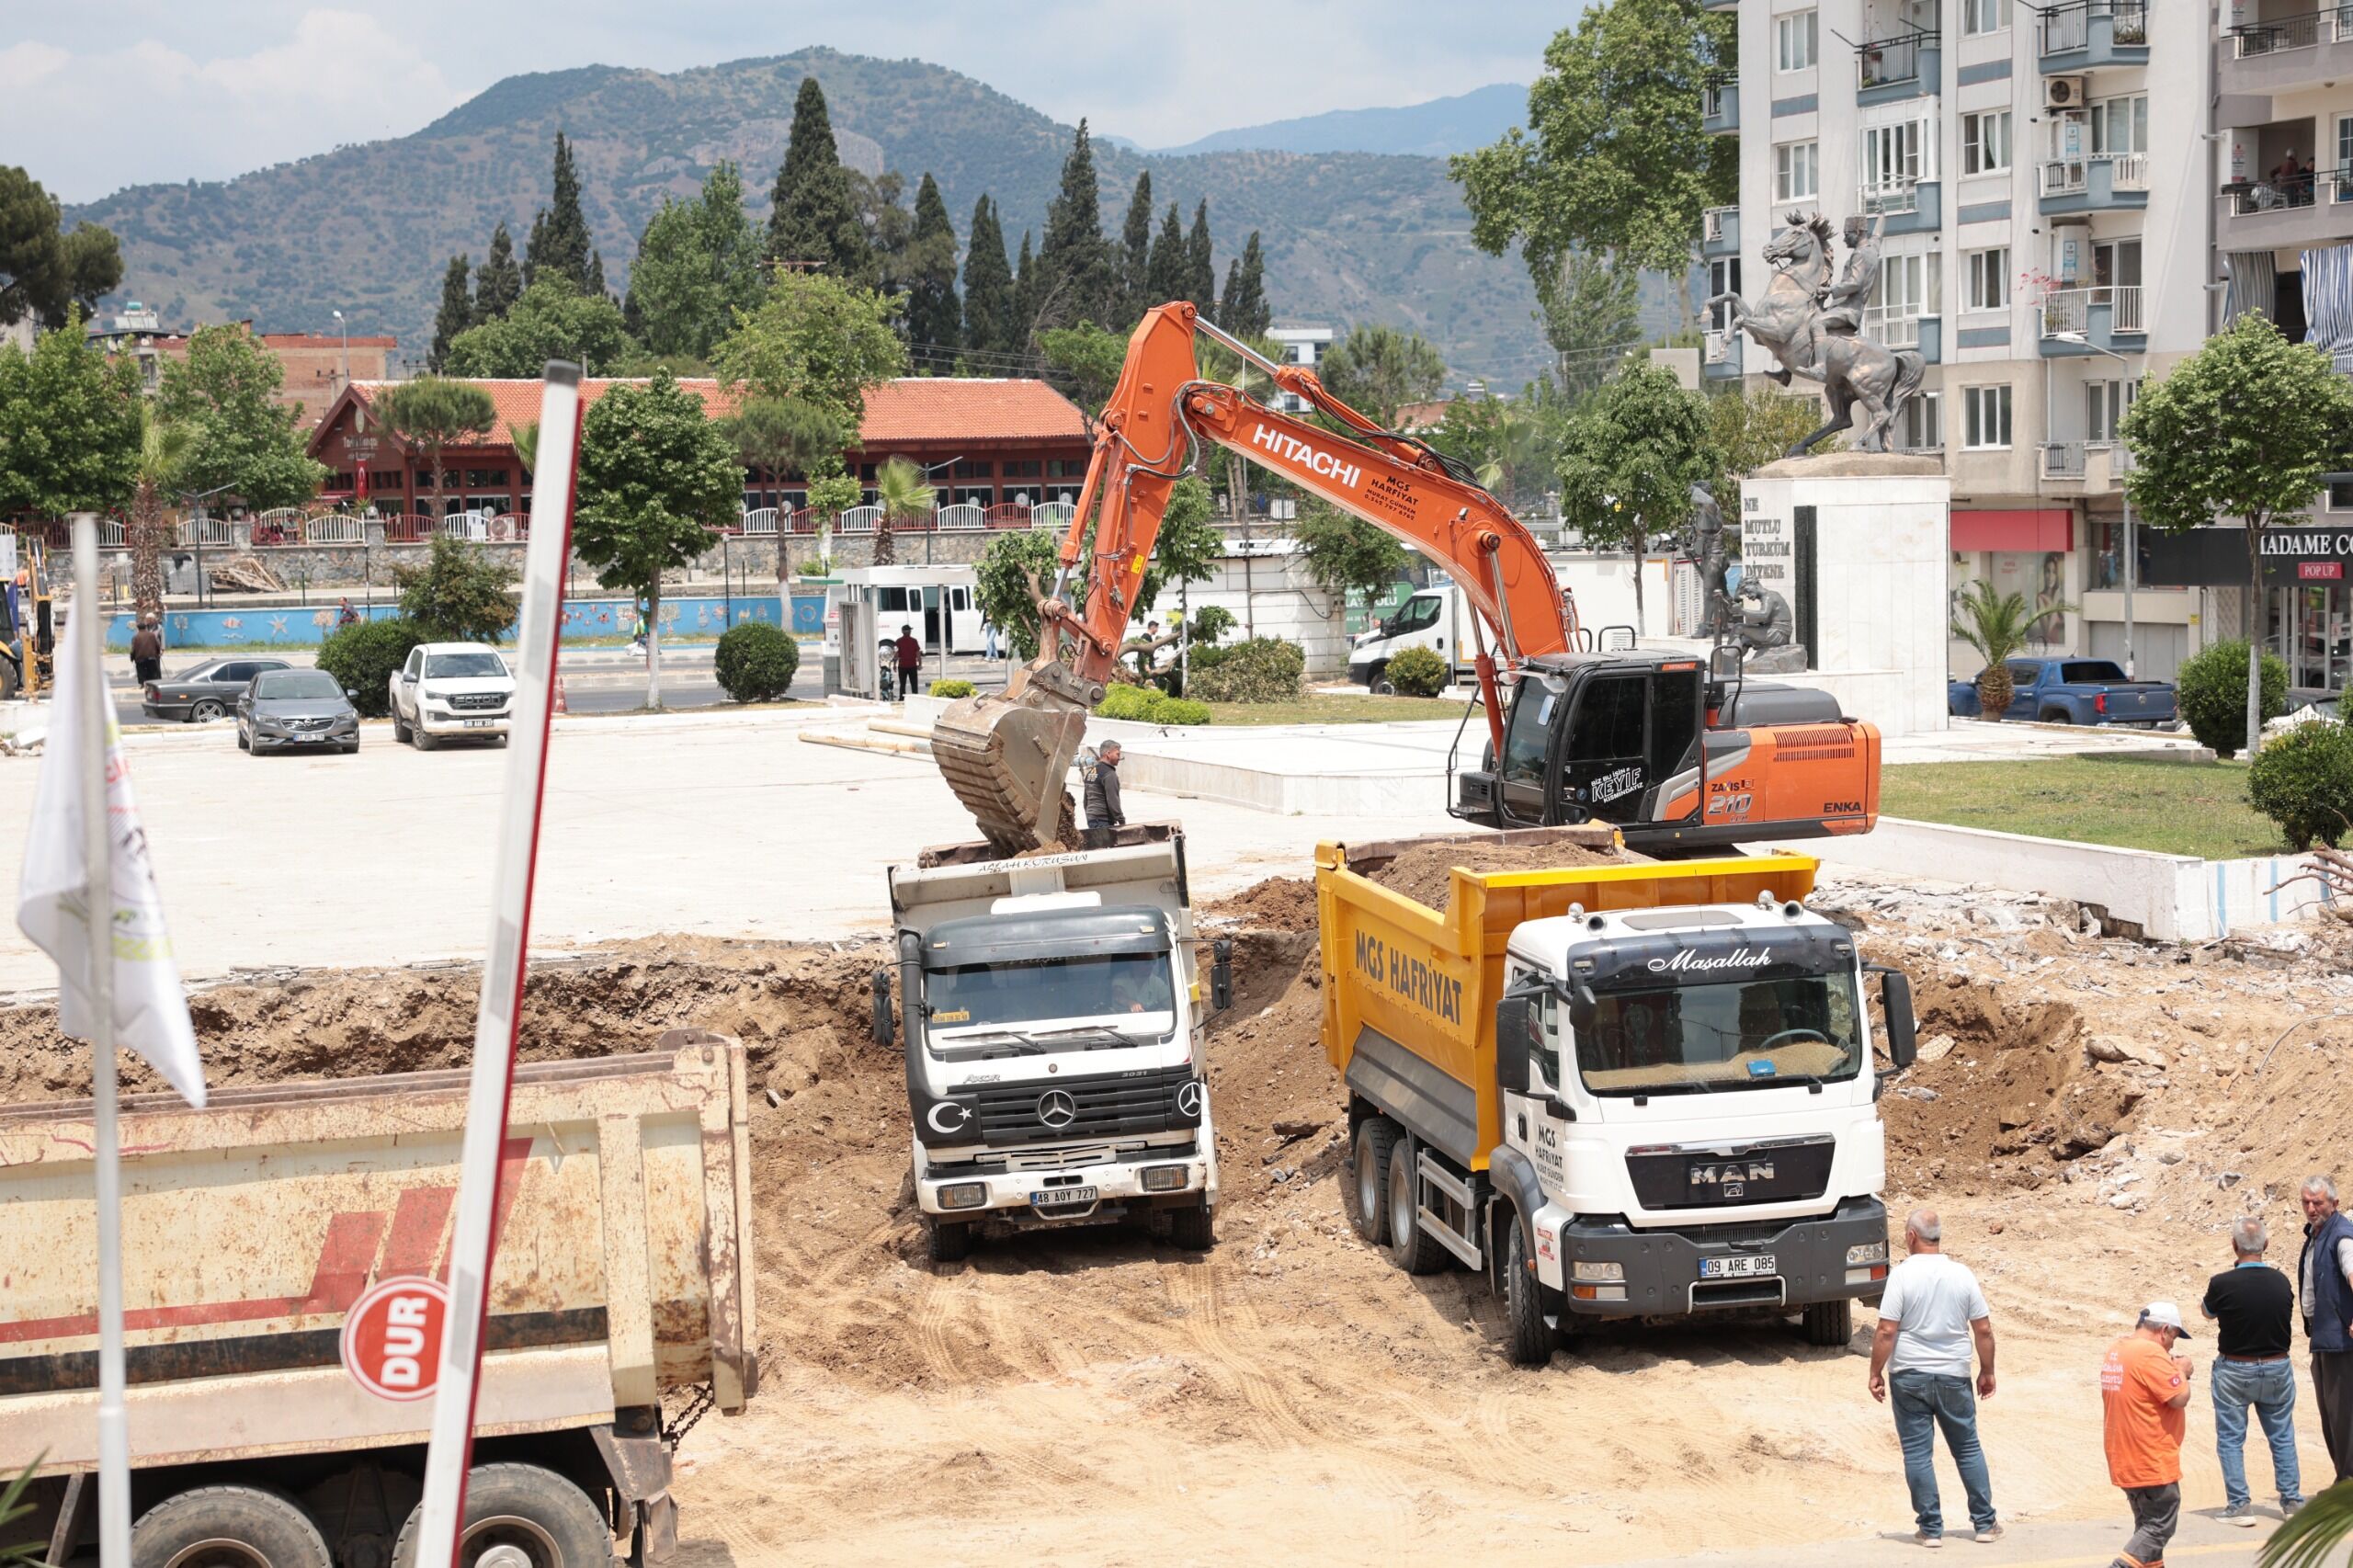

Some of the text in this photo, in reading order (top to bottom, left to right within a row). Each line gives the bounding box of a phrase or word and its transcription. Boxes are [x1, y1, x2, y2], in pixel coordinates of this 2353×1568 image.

[1252, 424, 1361, 489] HITACHI
[1371, 479, 1418, 506] HARFİYAT
[1386, 476, 1411, 492] MGS
[1367, 488, 1388, 502] MURAT
[1745, 498, 1758, 511] NE
[1745, 519, 1781, 534] MUTLU
[1745, 537, 1790, 556] TÜRKÜM
[1745, 561, 1784, 579] DİYENE
[2304, 565, 2335, 577] POP UP
[1711, 780, 1740, 792] ZAXIS
[1707, 794, 1752, 815] 210
[1824, 801, 1861, 812] ENKA
[1356, 928, 1461, 1026] MGS HAFRİYAT
[1539, 1124, 1555, 1148] MGS
[1691, 1163, 1774, 1184] MAN
[1038, 1188, 1094, 1203] 48 AOY 727
[1708, 1257, 1774, 1273] 09 ARE 085
[381, 1297, 428, 1386] DUR
